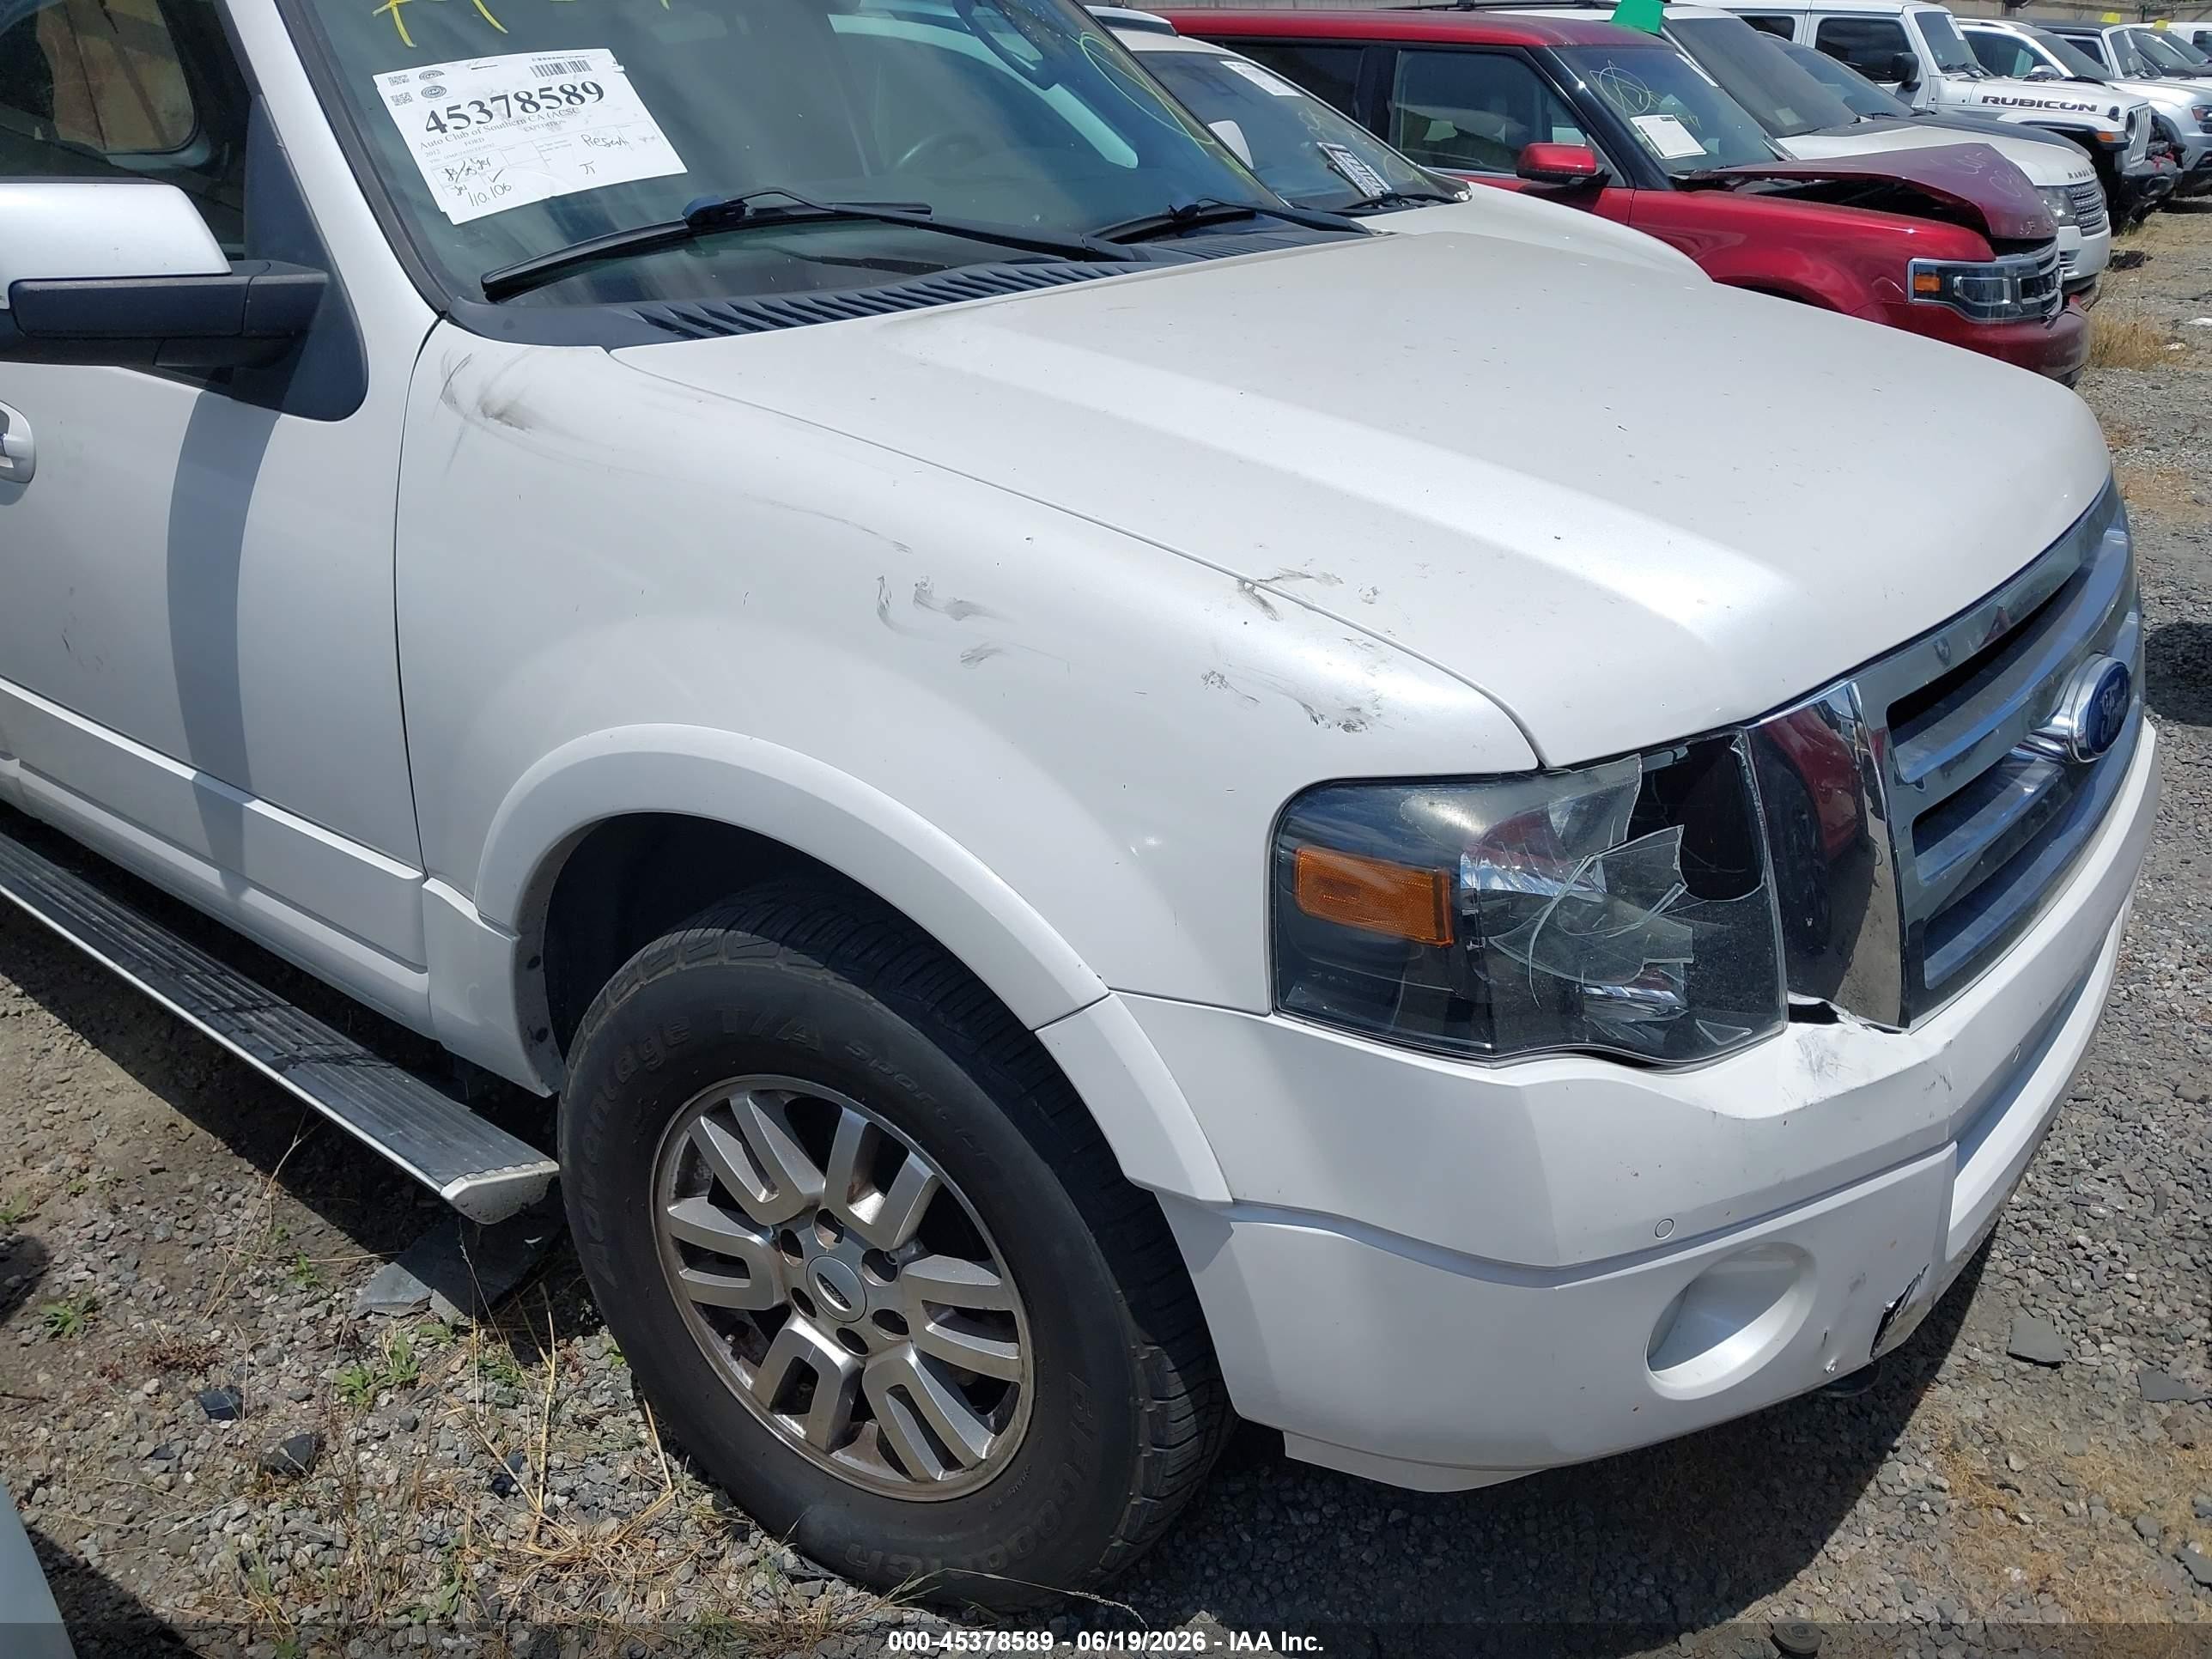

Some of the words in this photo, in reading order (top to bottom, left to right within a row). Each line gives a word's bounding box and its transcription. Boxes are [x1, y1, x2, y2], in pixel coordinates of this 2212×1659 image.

[425, 81, 605, 134] 45378589
[1981, 95, 2098, 112] RUBICON
[420, 138, 443, 150] Auto
[445, 130, 470, 143] Club
[472, 125, 483, 136] of
[484, 116, 526, 132] Southern
[528, 113, 545, 123] CA
